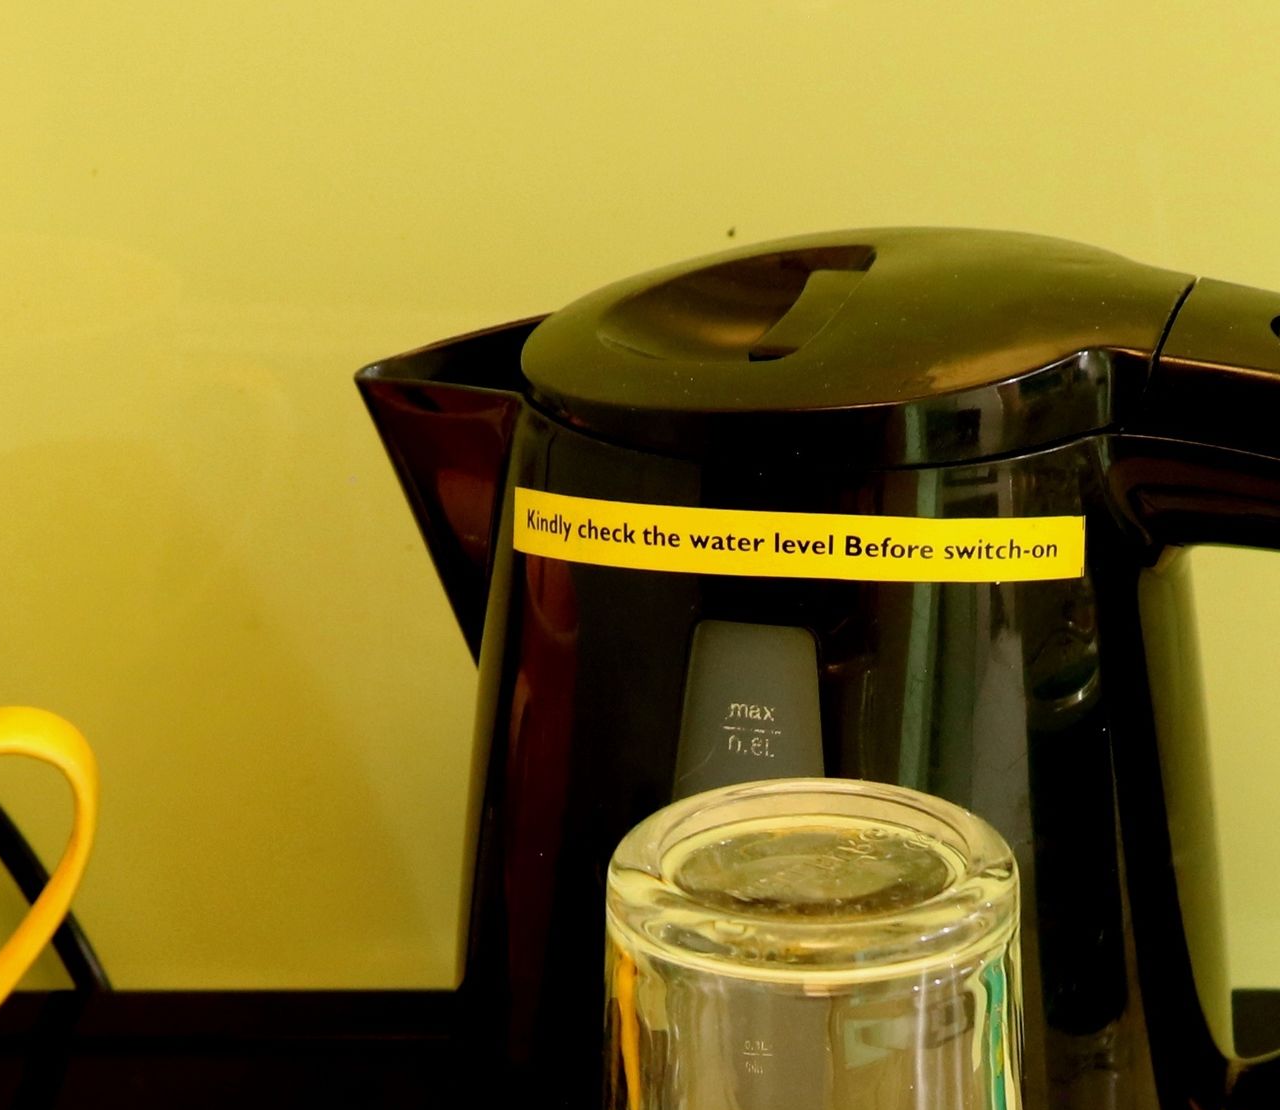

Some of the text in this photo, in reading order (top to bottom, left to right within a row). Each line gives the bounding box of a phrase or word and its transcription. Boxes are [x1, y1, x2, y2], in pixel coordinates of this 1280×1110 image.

[526, 508, 1059, 560] Kindly check the water level Before switch-on
